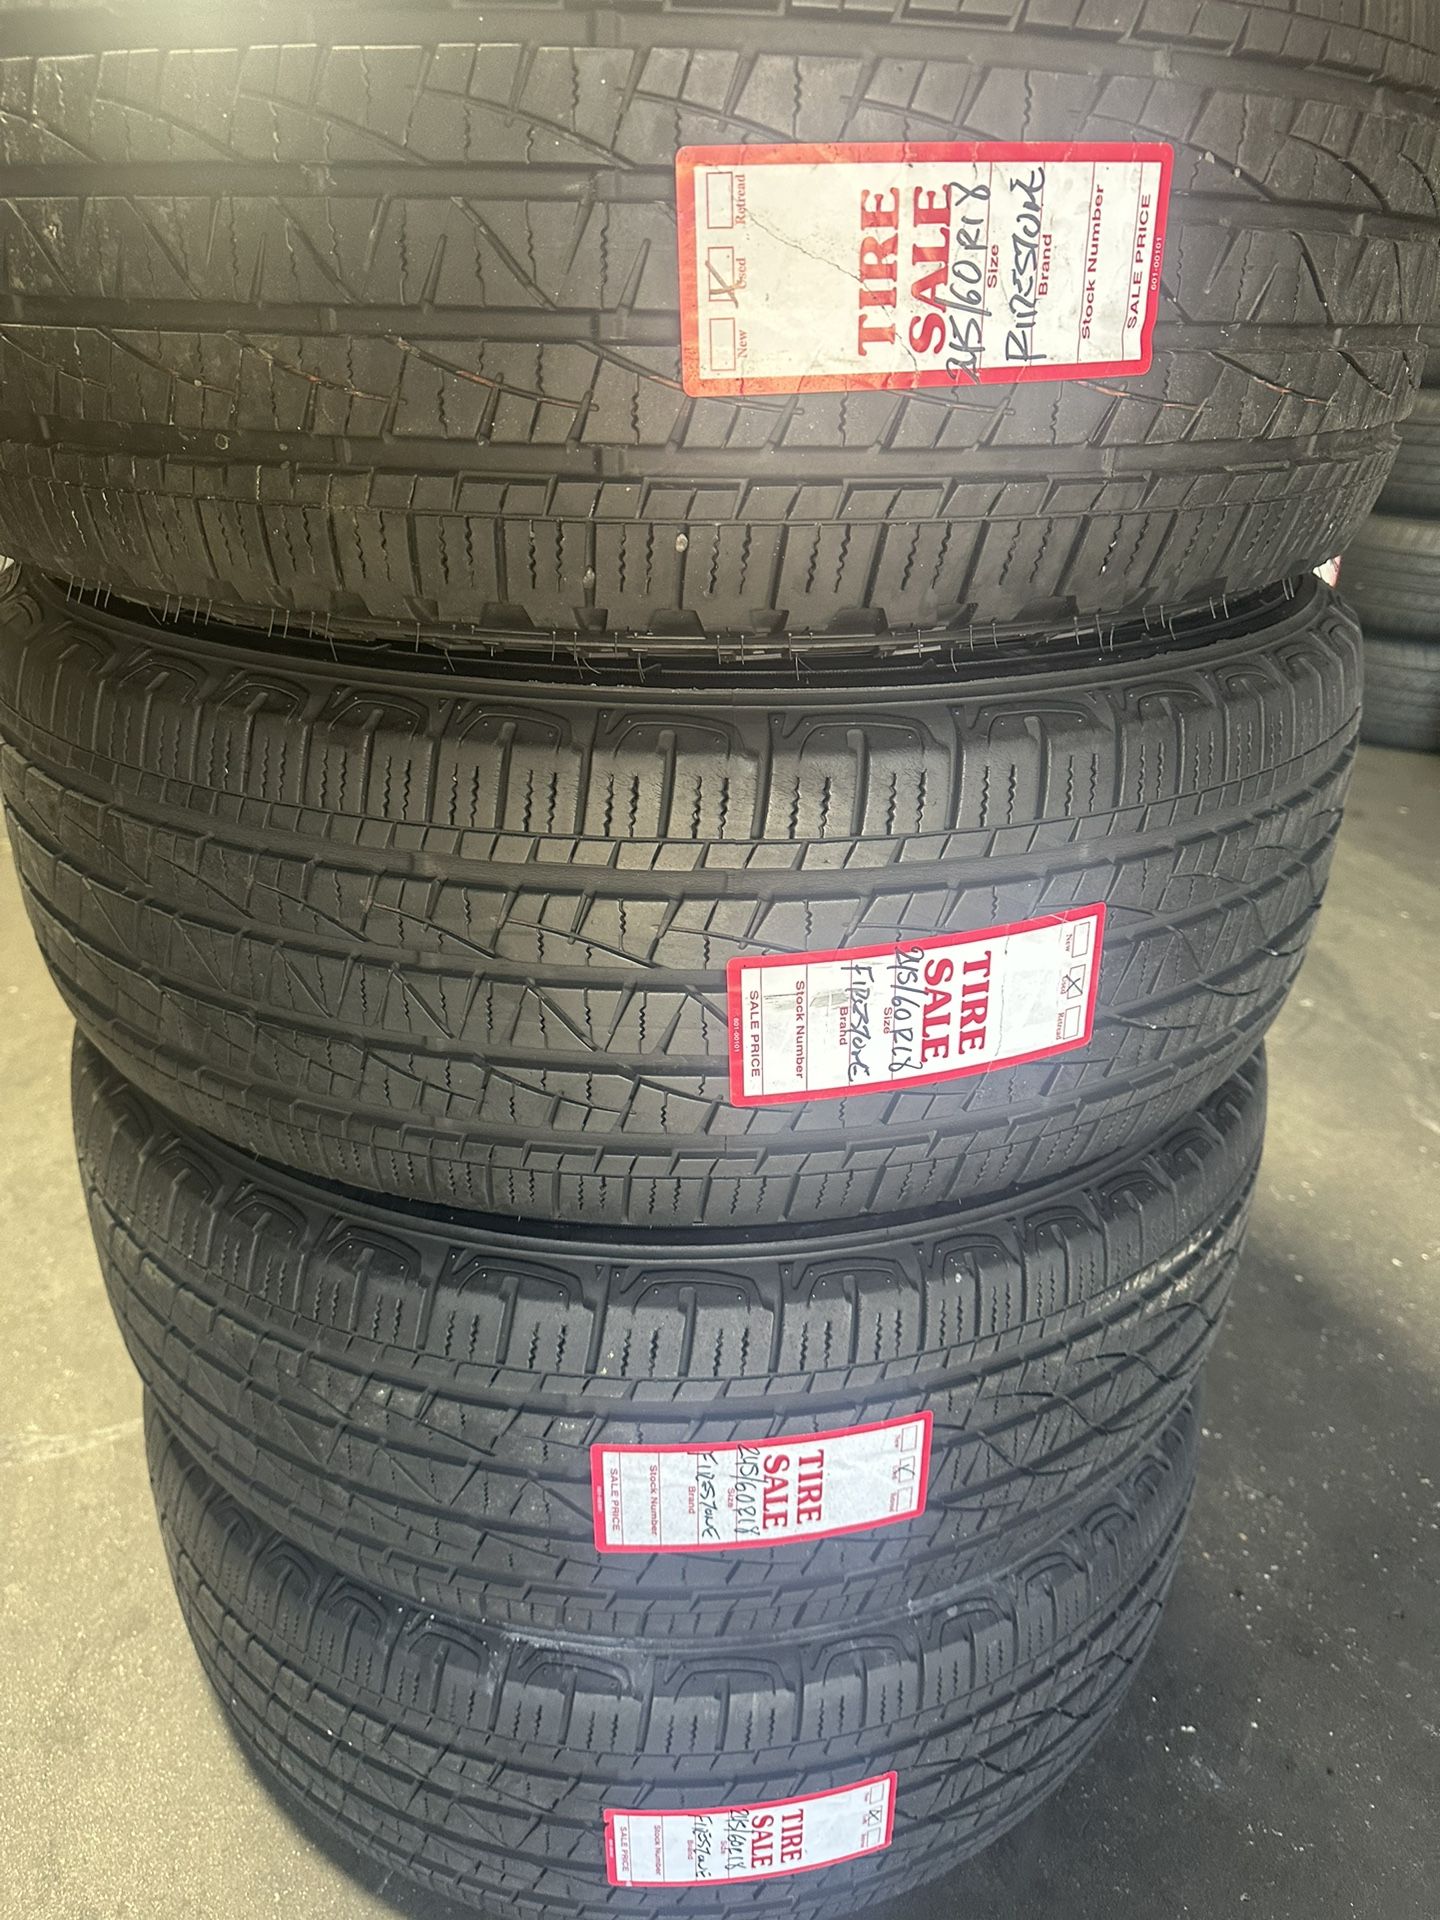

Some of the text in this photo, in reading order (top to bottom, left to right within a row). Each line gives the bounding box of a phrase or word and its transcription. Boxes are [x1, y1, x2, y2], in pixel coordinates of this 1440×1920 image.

[735, 175, 746, 225] Retread
[858, 187, 900, 356] TIRE
[909, 184, 952, 354] SALE
[988, 245, 998, 288] Size
[1038, 234, 1052, 296] Brand
[1082, 185, 1104, 339] Stock Number
[1127, 195, 1151, 329] SALE PRICE
[736, 330, 747, 358] New
[795, 980, 805, 1018] Stock
[839, 1007, 847, 1045] Brand
[883, 1007, 891, 1034] Size
[921, 958, 954, 1063] SALE
[959, 951, 992, 1055] TIRE
[1055, 1012, 1064, 1040] Retread
[750, 991, 760, 1076] SALE PRICE
[610, 1468, 619, 1531] SALE PRICE
[650, 1465, 658, 1536] Stock Number
[688, 1486, 696, 1514] Brand
[727, 1488, 735, 1508] Size
[762, 1454, 790, 1530] SALE
[797, 1449, 824, 1524] TIRE
[621, 1850, 629, 1872] PRICE
[751, 1815, 774, 1869] SALE
[781, 1809, 803, 1864] TIRE
